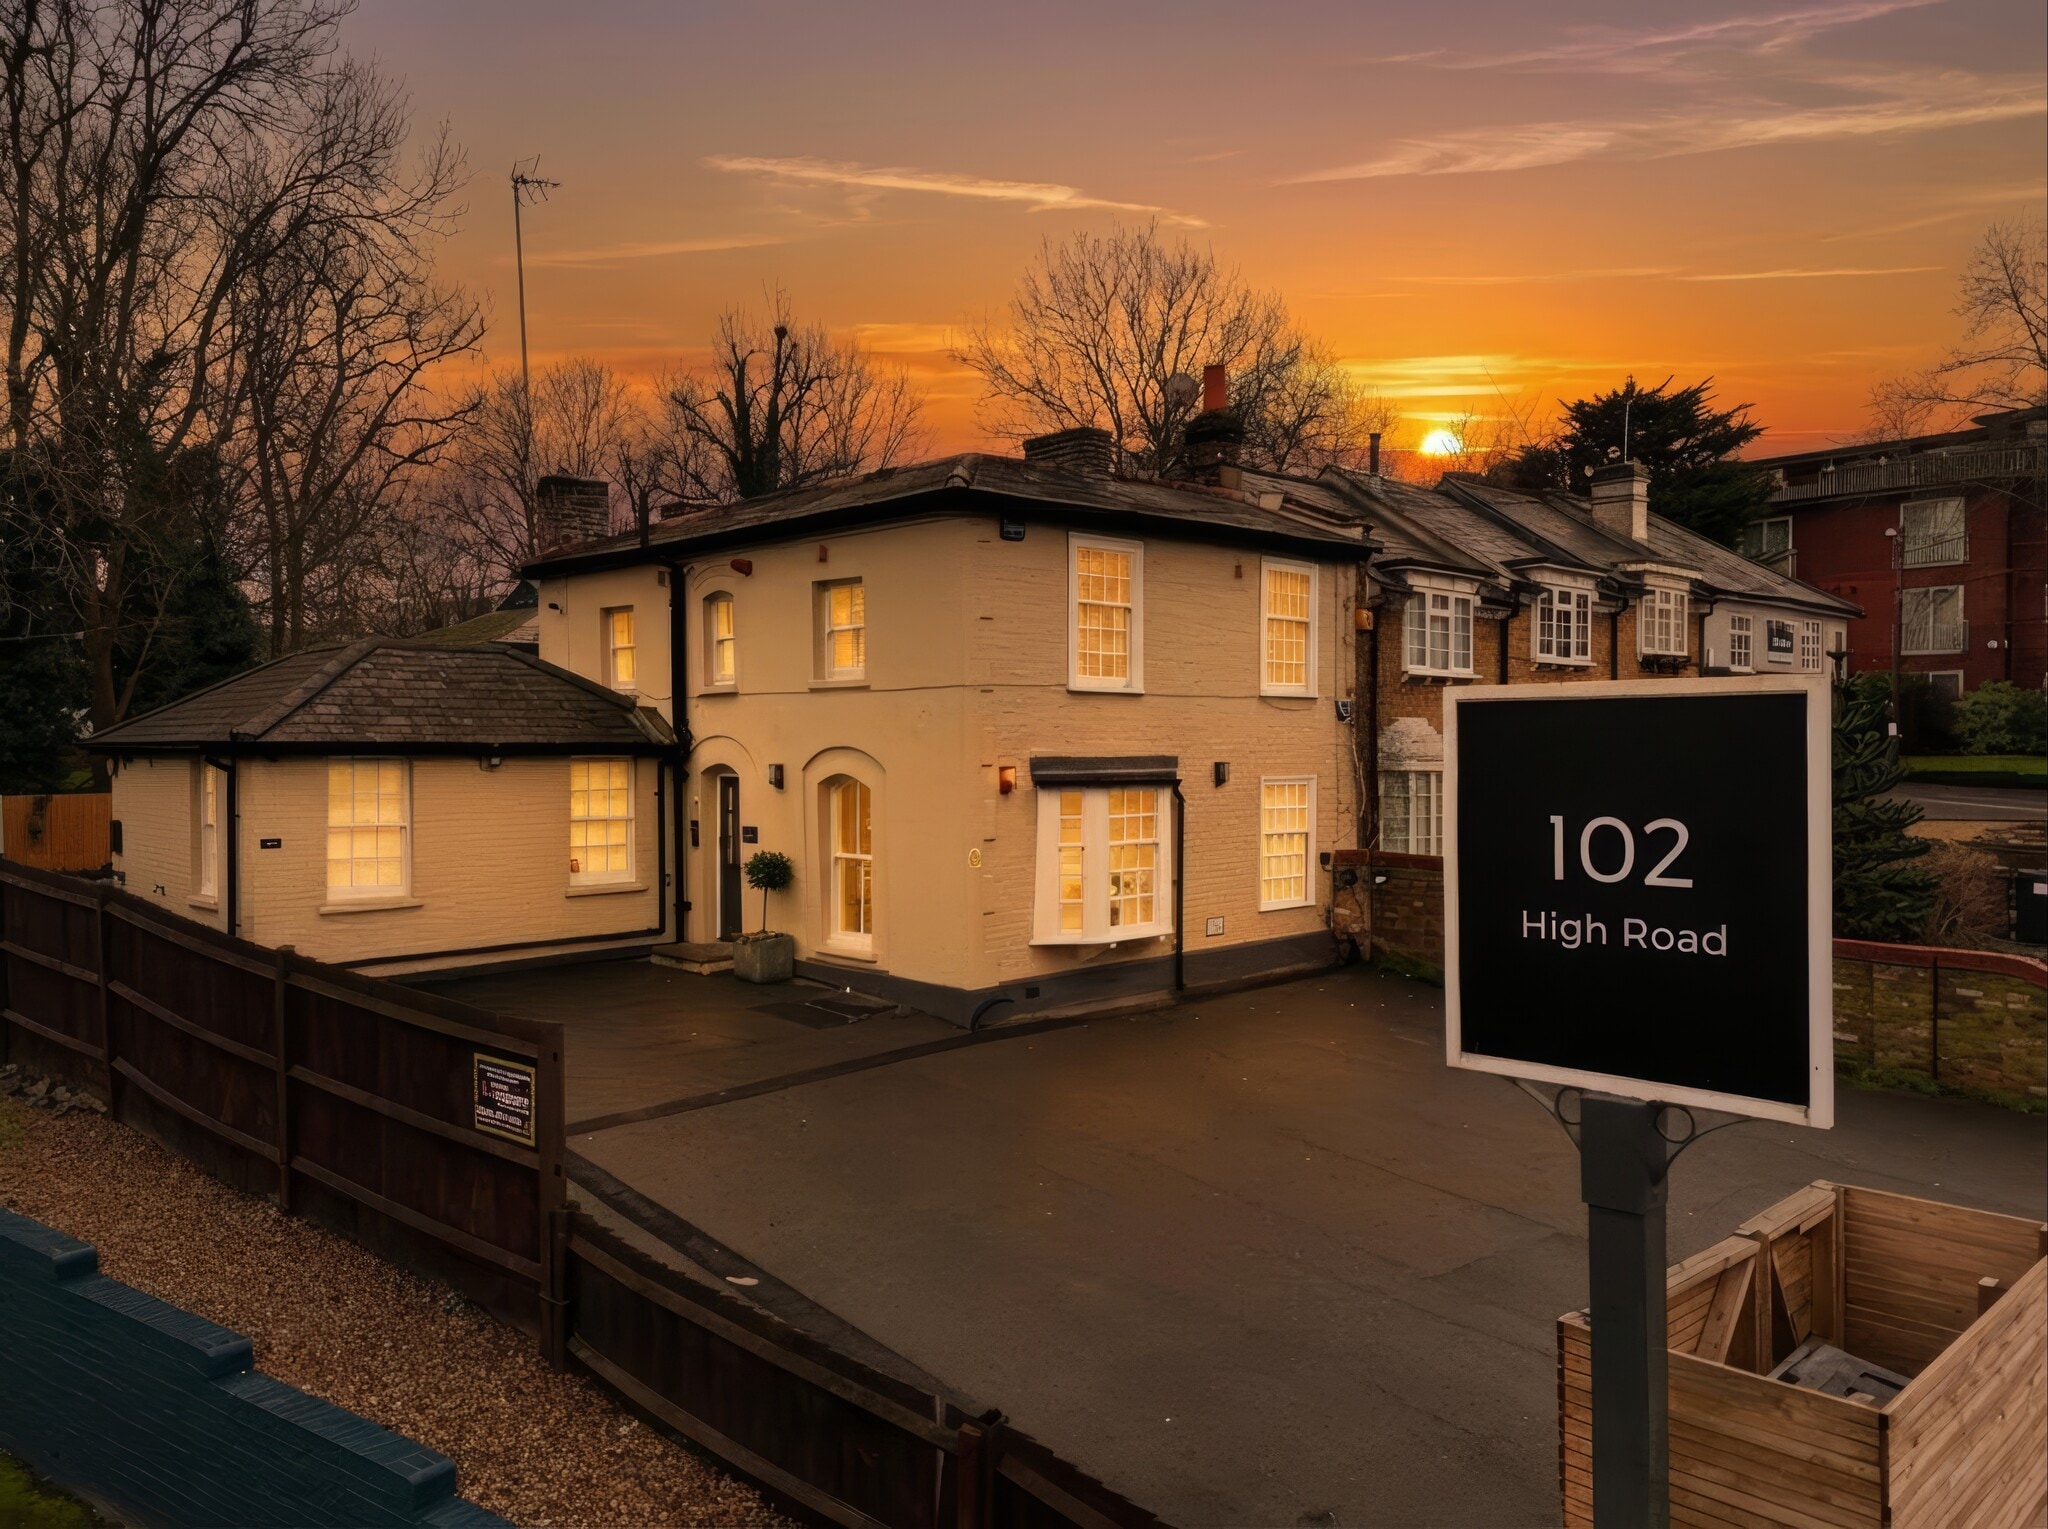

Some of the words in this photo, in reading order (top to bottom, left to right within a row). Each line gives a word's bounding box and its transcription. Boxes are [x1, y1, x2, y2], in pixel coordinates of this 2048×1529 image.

[1550, 815, 1693, 888] 102
[1522, 910, 1607, 949] High
[1623, 918, 1727, 957] Road
